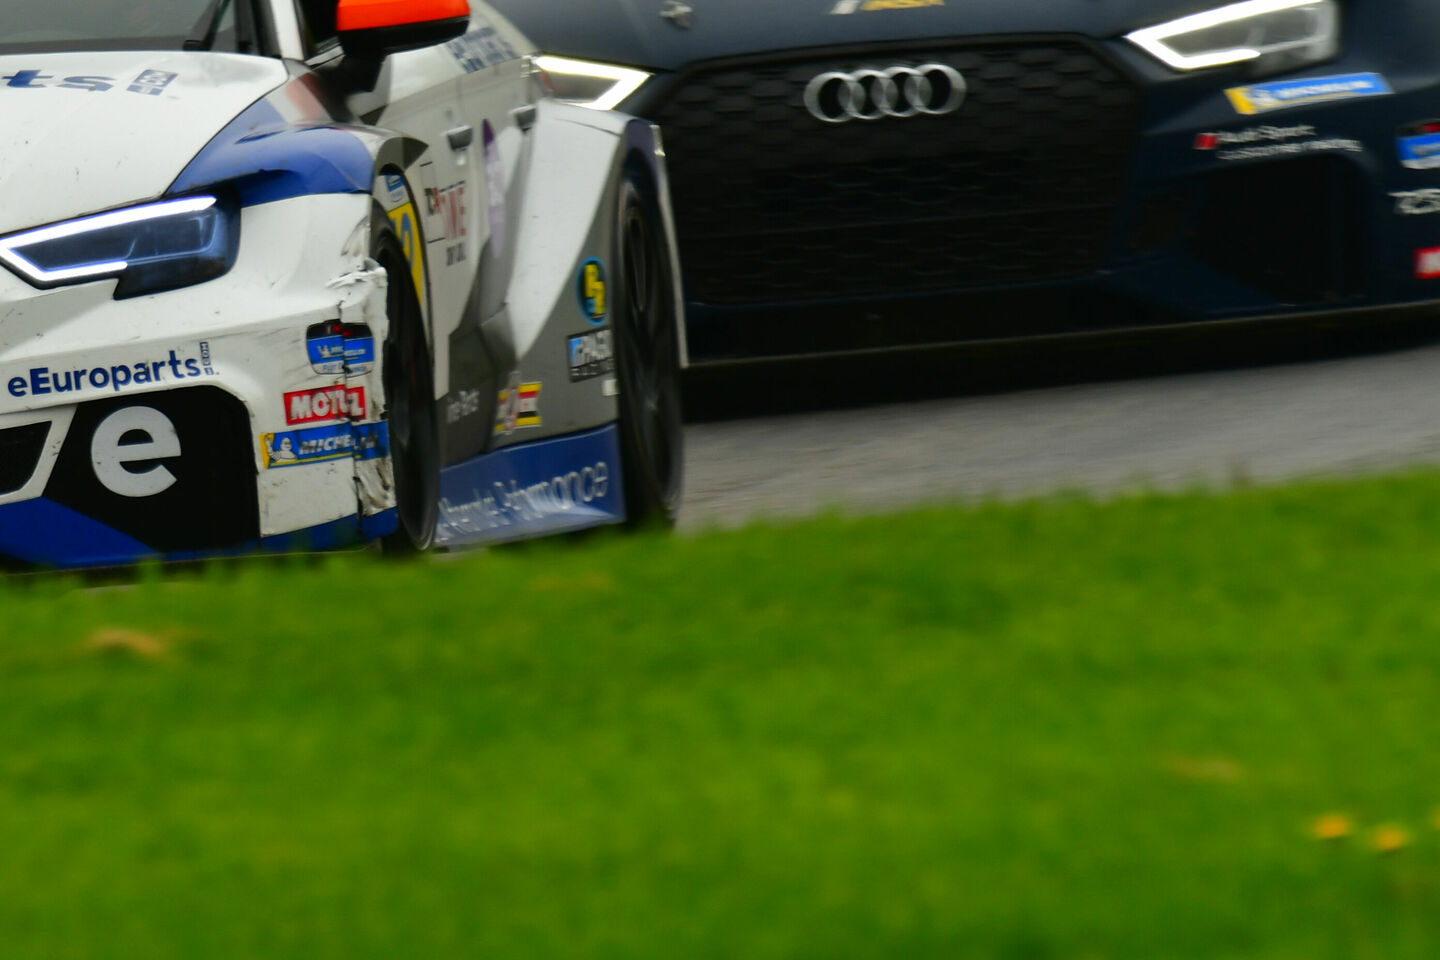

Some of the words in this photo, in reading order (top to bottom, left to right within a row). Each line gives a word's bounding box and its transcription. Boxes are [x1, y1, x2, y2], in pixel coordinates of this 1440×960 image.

[7, 349, 200, 398] eEuroparts
[290, 389, 364, 421] MOTUL
[91, 406, 181, 498] e
